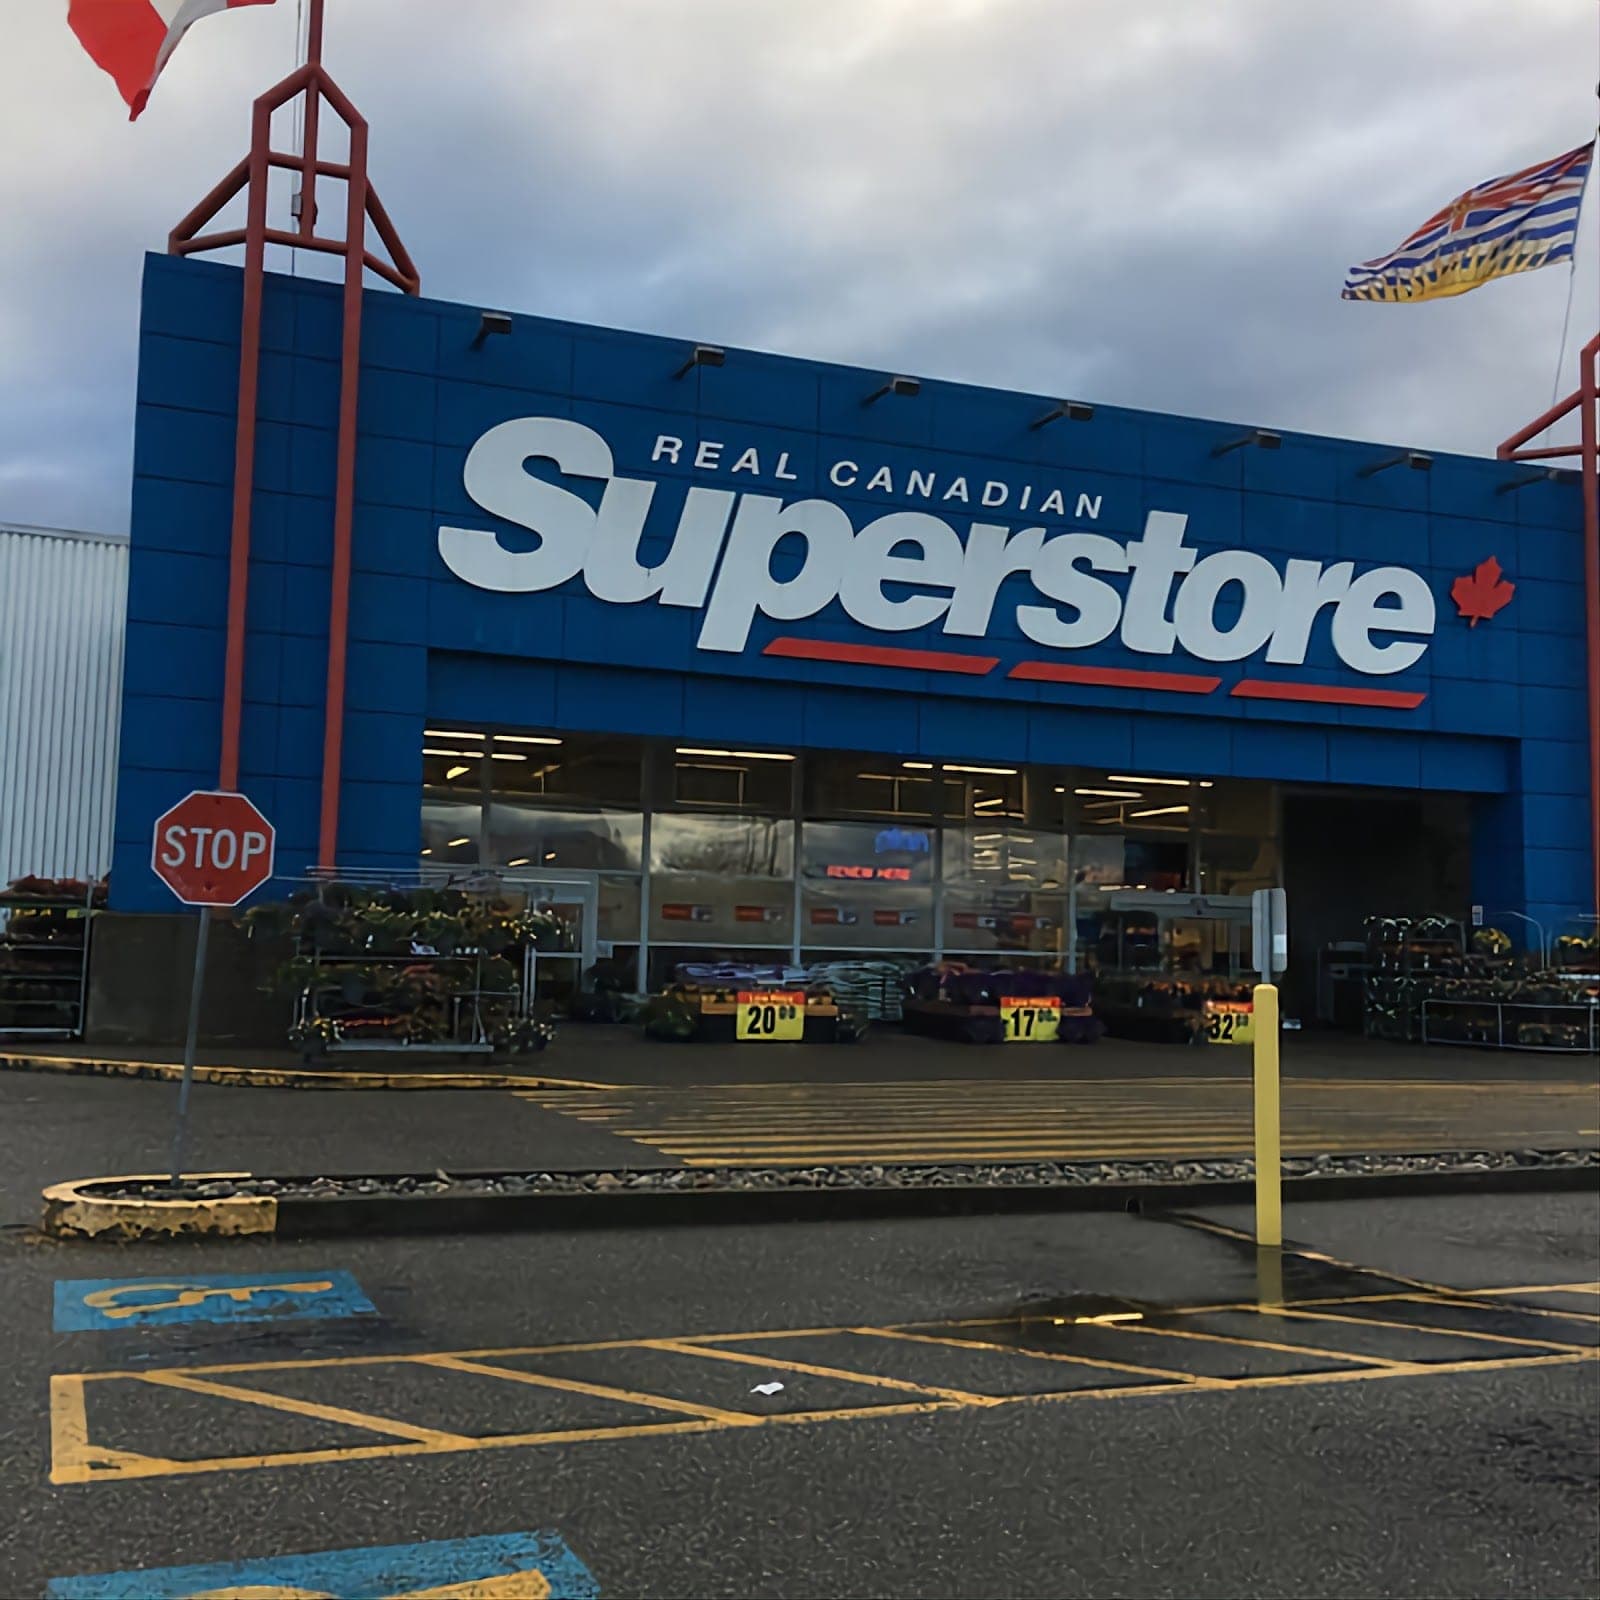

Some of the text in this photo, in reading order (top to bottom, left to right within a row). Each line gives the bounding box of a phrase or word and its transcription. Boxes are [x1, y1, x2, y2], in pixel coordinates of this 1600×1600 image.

[651, 434, 1103, 519] REAL CANADIAN
[437, 416, 1436, 675] Superstore
[162, 825, 266, 871] STOP
[747, 1005, 776, 1034] 20
[1011, 1008, 1035, 1036] 17
